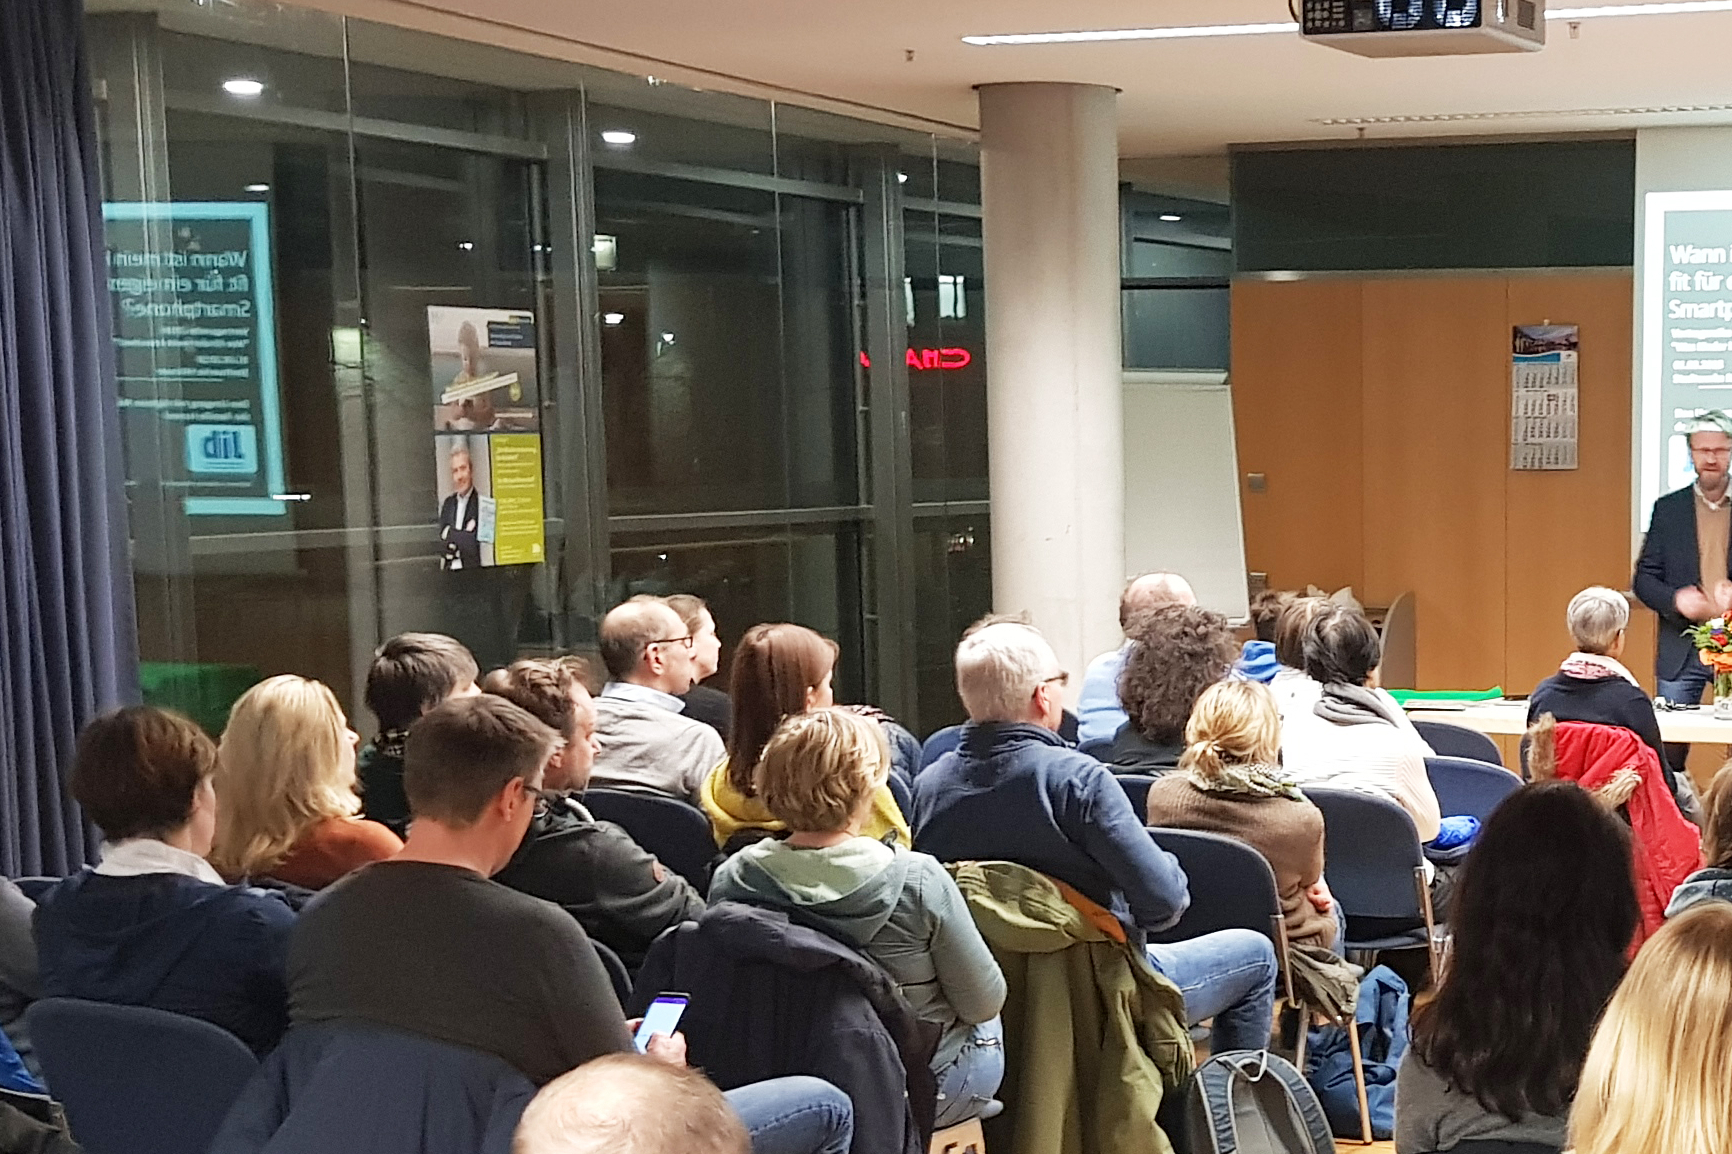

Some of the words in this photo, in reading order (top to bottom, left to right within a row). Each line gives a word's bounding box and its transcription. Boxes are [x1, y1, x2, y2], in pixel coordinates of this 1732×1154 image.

[1669, 243, 1726, 264] Wann
[1668, 270, 1691, 291] fit
[1694, 270, 1724, 291] für
